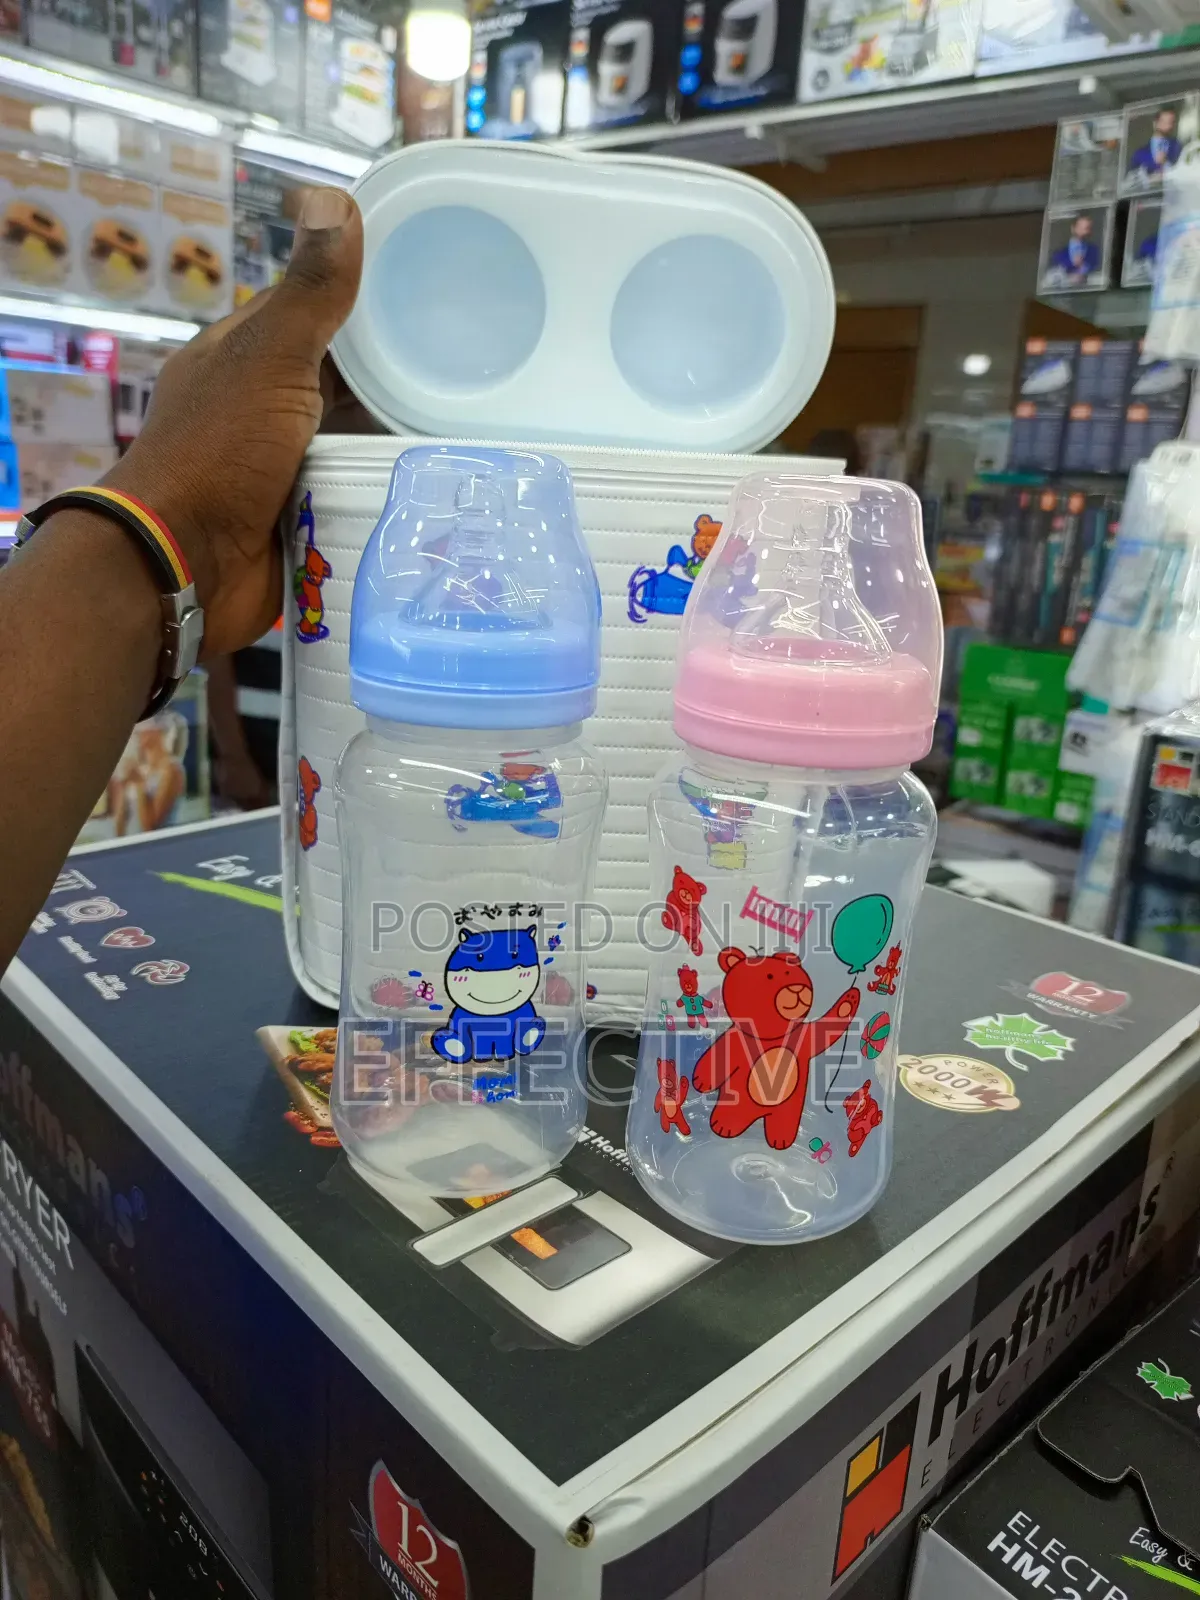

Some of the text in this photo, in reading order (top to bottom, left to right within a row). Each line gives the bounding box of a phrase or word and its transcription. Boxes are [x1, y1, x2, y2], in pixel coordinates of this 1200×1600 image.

[1026, 993, 1098, 1019] WARRANTY
[1056, 980, 1105, 1003] 12
[900, 1058, 1013, 1107] 2000W
[943, 1059, 999, 1085] POWER
[0, 1131, 74, 1271] RYER
[928, 1183, 1160, 1447] Hoffmans
[397, 1501, 439, 1588] 12
[1129, 1526, 1196, 1571] Easy &
[397, 1552, 438, 1600] MONTHS
